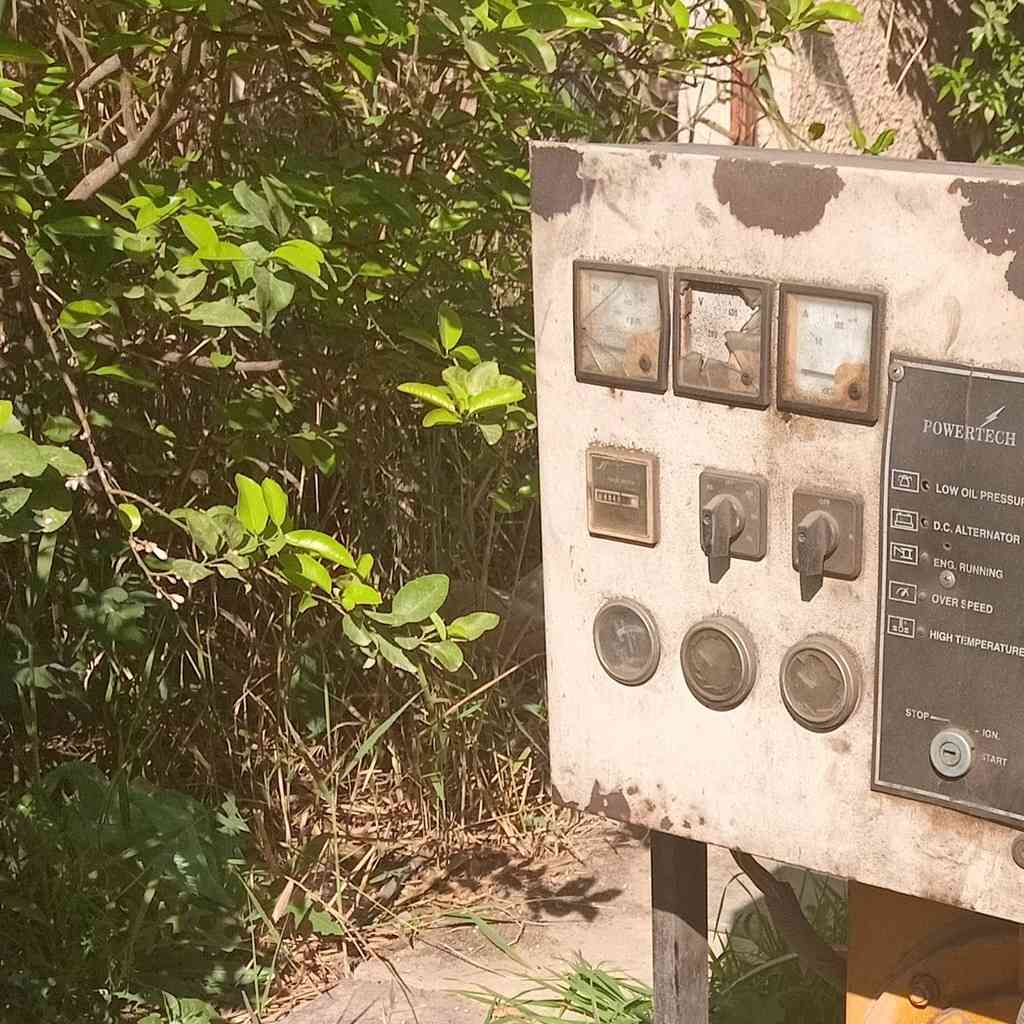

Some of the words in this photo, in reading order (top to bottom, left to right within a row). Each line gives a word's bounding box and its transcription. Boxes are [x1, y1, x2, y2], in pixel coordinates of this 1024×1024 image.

[922, 419, 1017, 447] POWERTECH
[935, 483, 959, 497] LOW
[961, 487, 978, 500] OIL
[933, 520, 953, 533] D.C.
[954, 524, 1021, 545] ALTERNATOR
[933, 557, 956, 571] ENG.
[958, 562, 1004, 579] RUNNING
[931, 593, 959, 608] OVER
[960, 598, 994, 615] SPEED
[929, 629, 953, 644] HIGH
[904, 707, 930, 721] STOP
